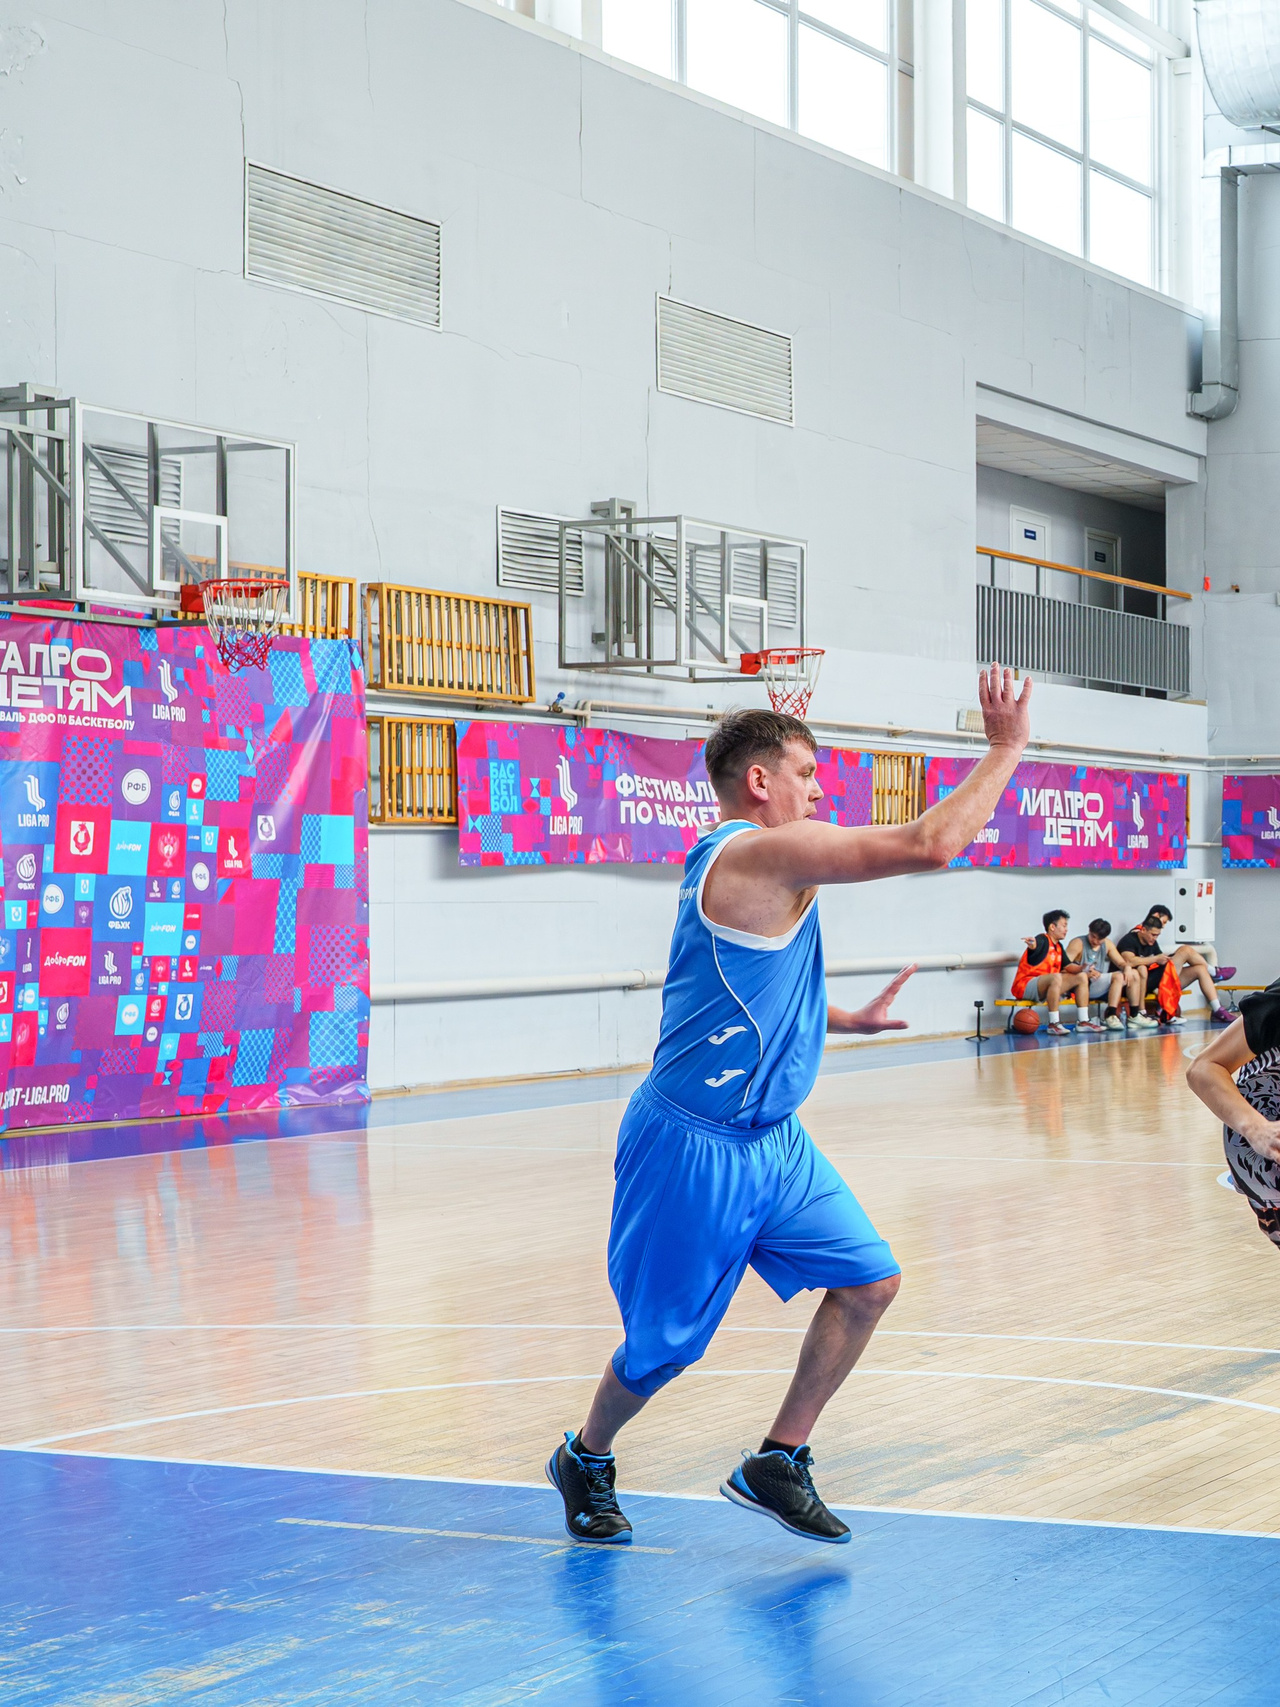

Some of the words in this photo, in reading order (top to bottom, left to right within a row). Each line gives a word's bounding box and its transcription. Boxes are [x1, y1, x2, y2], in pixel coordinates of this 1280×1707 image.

[152, 704, 170, 720] LIGA
[171, 707, 186, 722] PRO
[28, 713, 56, 724] ДФО
[57, 715, 67, 725] ПО
[68, 715, 135, 731] БАСКЕТБОЛУ
[490, 763, 515, 779] БАС
[127, 782, 147, 791] РФБ
[490, 780, 515, 794] КЕТ
[490, 797, 519, 812] БОЛ
[1020, 787, 1103, 819] ЛИГАПРО
[18, 814, 36, 827] LIGA
[38, 814, 50, 827] PRO
[620, 802, 652, 824] ПО
[657, 808, 721, 828] БАСКЕТ
[550, 816, 568, 835] LIGA
[569, 816, 583, 835] PRO
[1043, 818, 1113, 847] ДЕТЯМ
[985, 828, 999, 844] PRO
[1127, 835, 1137, 849] LIGA
[1138, 835, 1149, 849] PRO
[1261, 831, 1274, 839] LIGA
[45, 894, 60, 903] РФБ
[108, 921, 130, 929] ФБХК
[44, 952, 87, 966] ДоброFON
[110, 976, 121, 985] PRO
